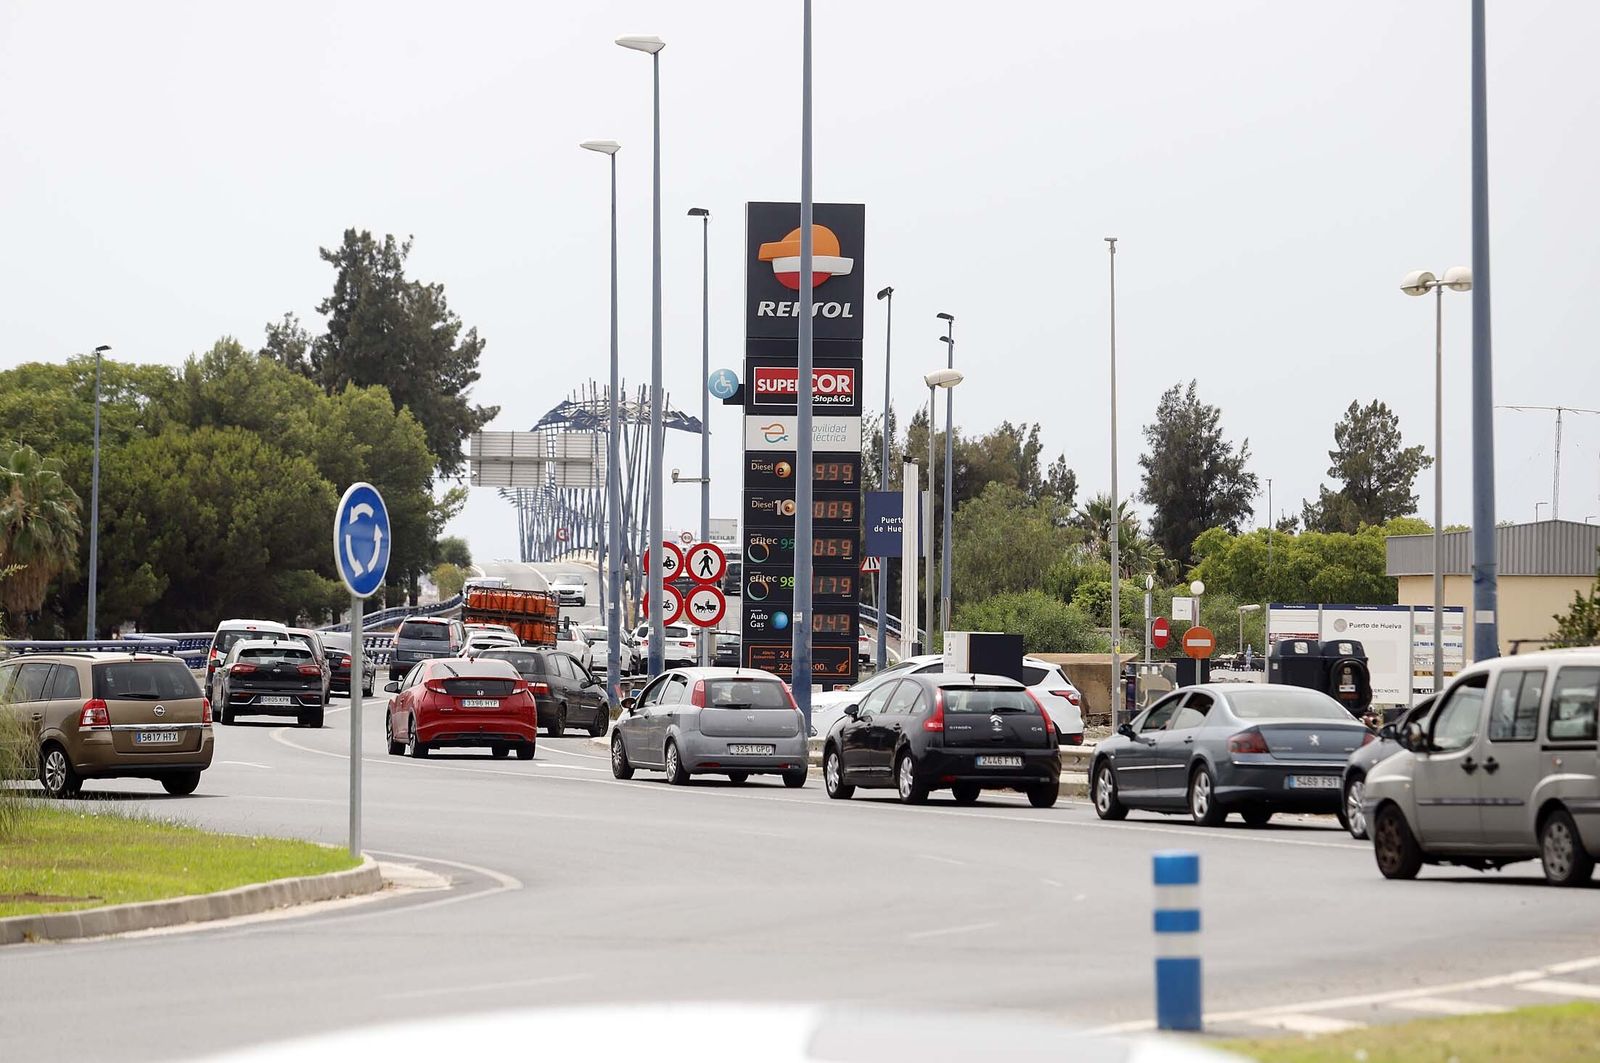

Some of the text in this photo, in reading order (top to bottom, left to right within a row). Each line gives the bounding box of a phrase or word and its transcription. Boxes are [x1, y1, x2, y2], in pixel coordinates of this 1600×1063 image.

[757, 374, 851, 393] SUPEOR
[814, 394, 851, 404] Stop&Go
[812, 424, 847, 433] ovilidad
[813, 432, 847, 442] léctrica
[751, 462, 774, 471] Diesel
[751, 499, 797, 516] Diesel 10
[873, 525, 884, 533] de
[750, 536, 778, 545] efitec
[749, 574, 796, 588] efitec 98
[750, 612, 769, 620] Auto
[750, 620, 765, 628] Gas
[1349, 622, 1370, 630] Puerto
[779, 650, 789, 658] 24
[778, 663, 792, 671] 22:
[811, 663, 825, 671] :00
[142, 732, 177, 742] 5817 HTX
[736, 745, 753, 753] 3251
[982, 756, 1002, 765] 2446
